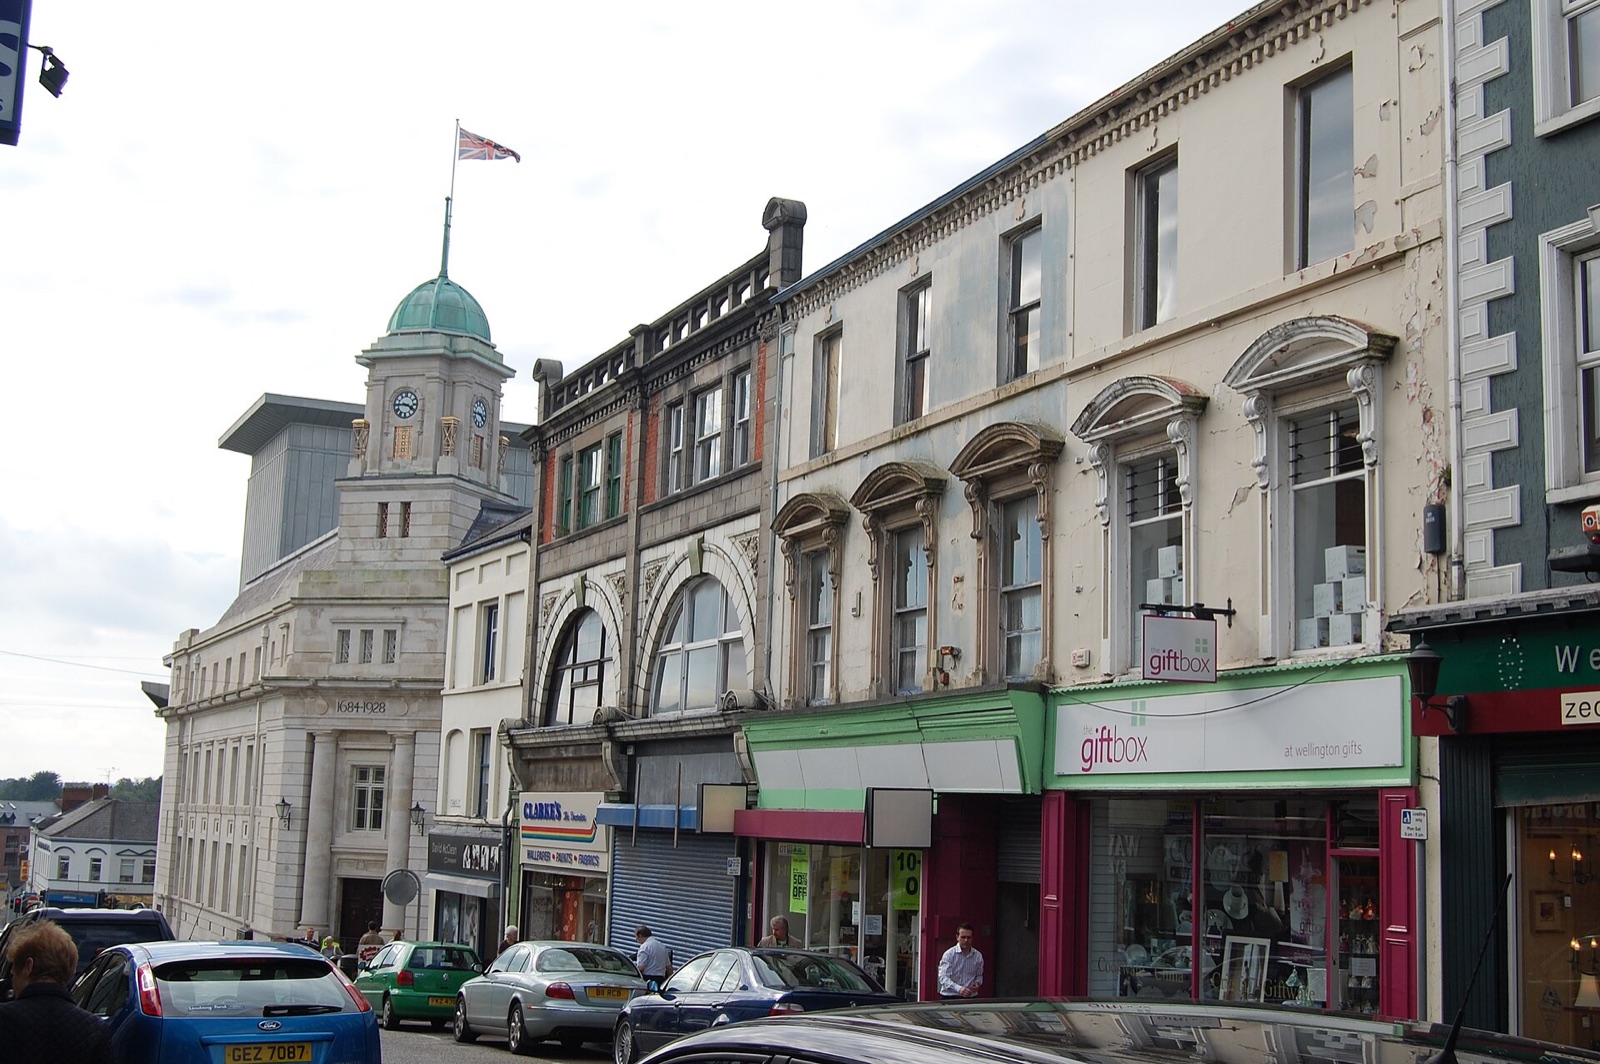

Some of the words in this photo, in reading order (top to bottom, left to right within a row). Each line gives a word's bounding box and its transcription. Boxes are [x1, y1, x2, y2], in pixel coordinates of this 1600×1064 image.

[1150, 649, 1210, 675] giftbox
[337, 700, 386, 714] 1684-1928
[1083, 725, 1093, 735] the
[1081, 725, 1147, 772] giftbox
[1284, 745, 1293, 757] at
[1296, 742, 1340, 759] wellington
[1342, 740, 1362, 758] gifts
[523, 801, 562, 821] CLARKE'S
[527, 850, 551, 862] WALLPAPER
[556, 852, 573, 864] PAINTS
[578, 854, 599, 867] FABRICS
[263, 1020, 276, 1028] Ford
[232, 1047, 262, 1061] GEZ
[267, 1045, 305, 1059] 7087
